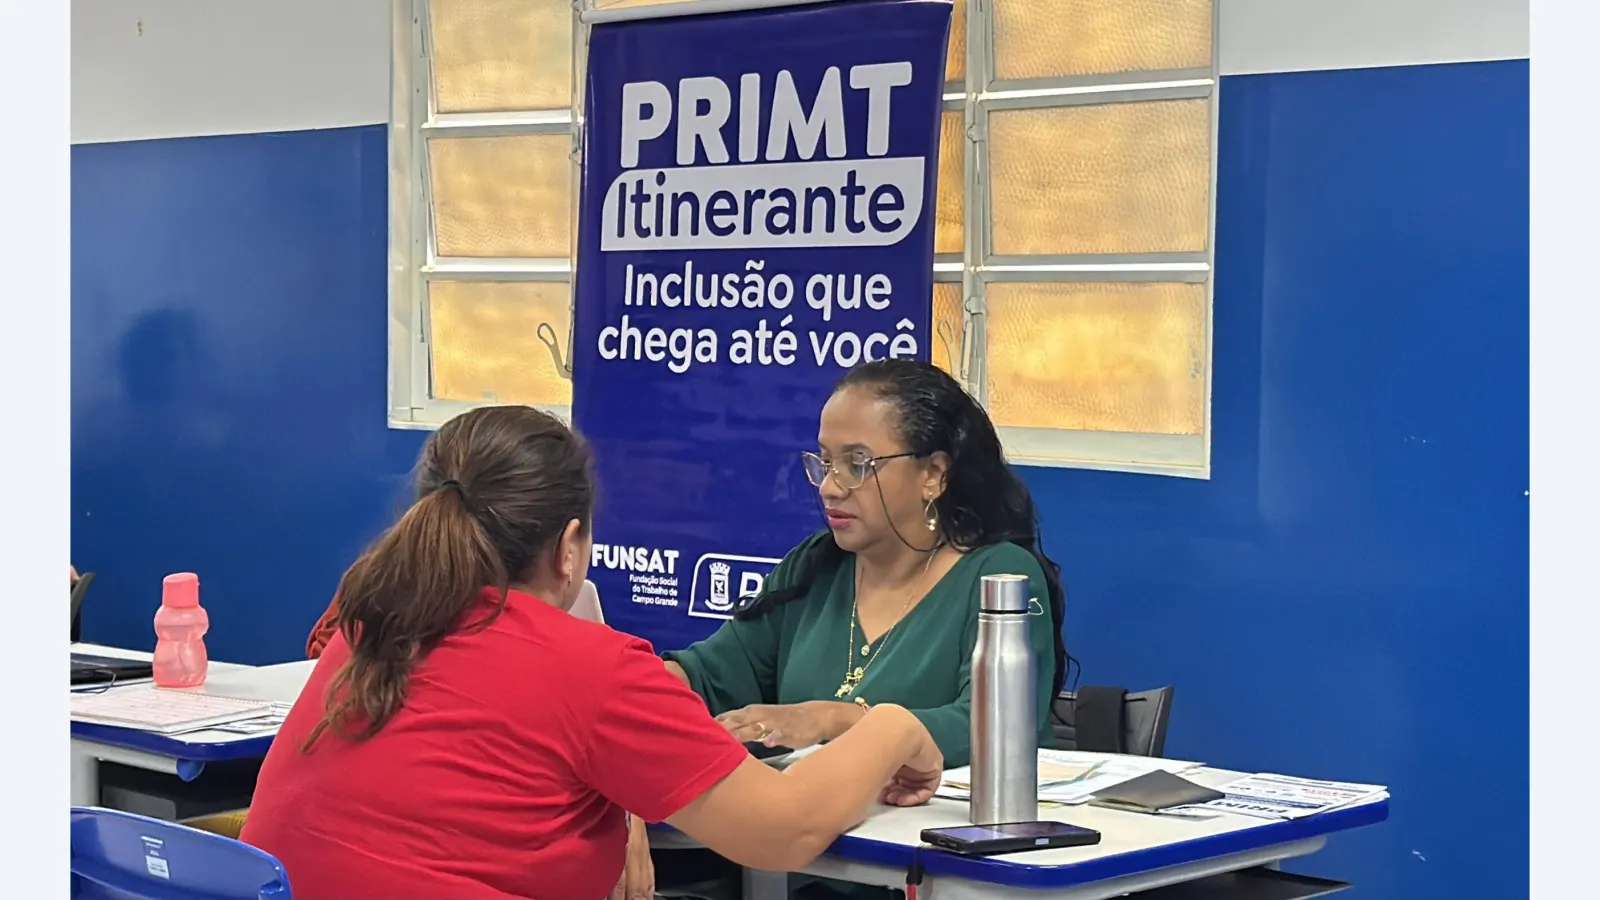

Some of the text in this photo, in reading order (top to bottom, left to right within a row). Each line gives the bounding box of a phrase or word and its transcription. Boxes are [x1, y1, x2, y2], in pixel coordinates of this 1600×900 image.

[620, 61, 913, 168] PRIMT
[616, 170, 905, 239] Itinerante
[624, 260, 892, 321] Inclusão que
[598, 315, 917, 374] chega até você
[591, 543, 680, 574] FUNSAT
[629, 574, 678, 586] Fundação Social
[632, 584, 678, 597] do Trabalho de
[632, 595, 678, 607] Campo Grande
